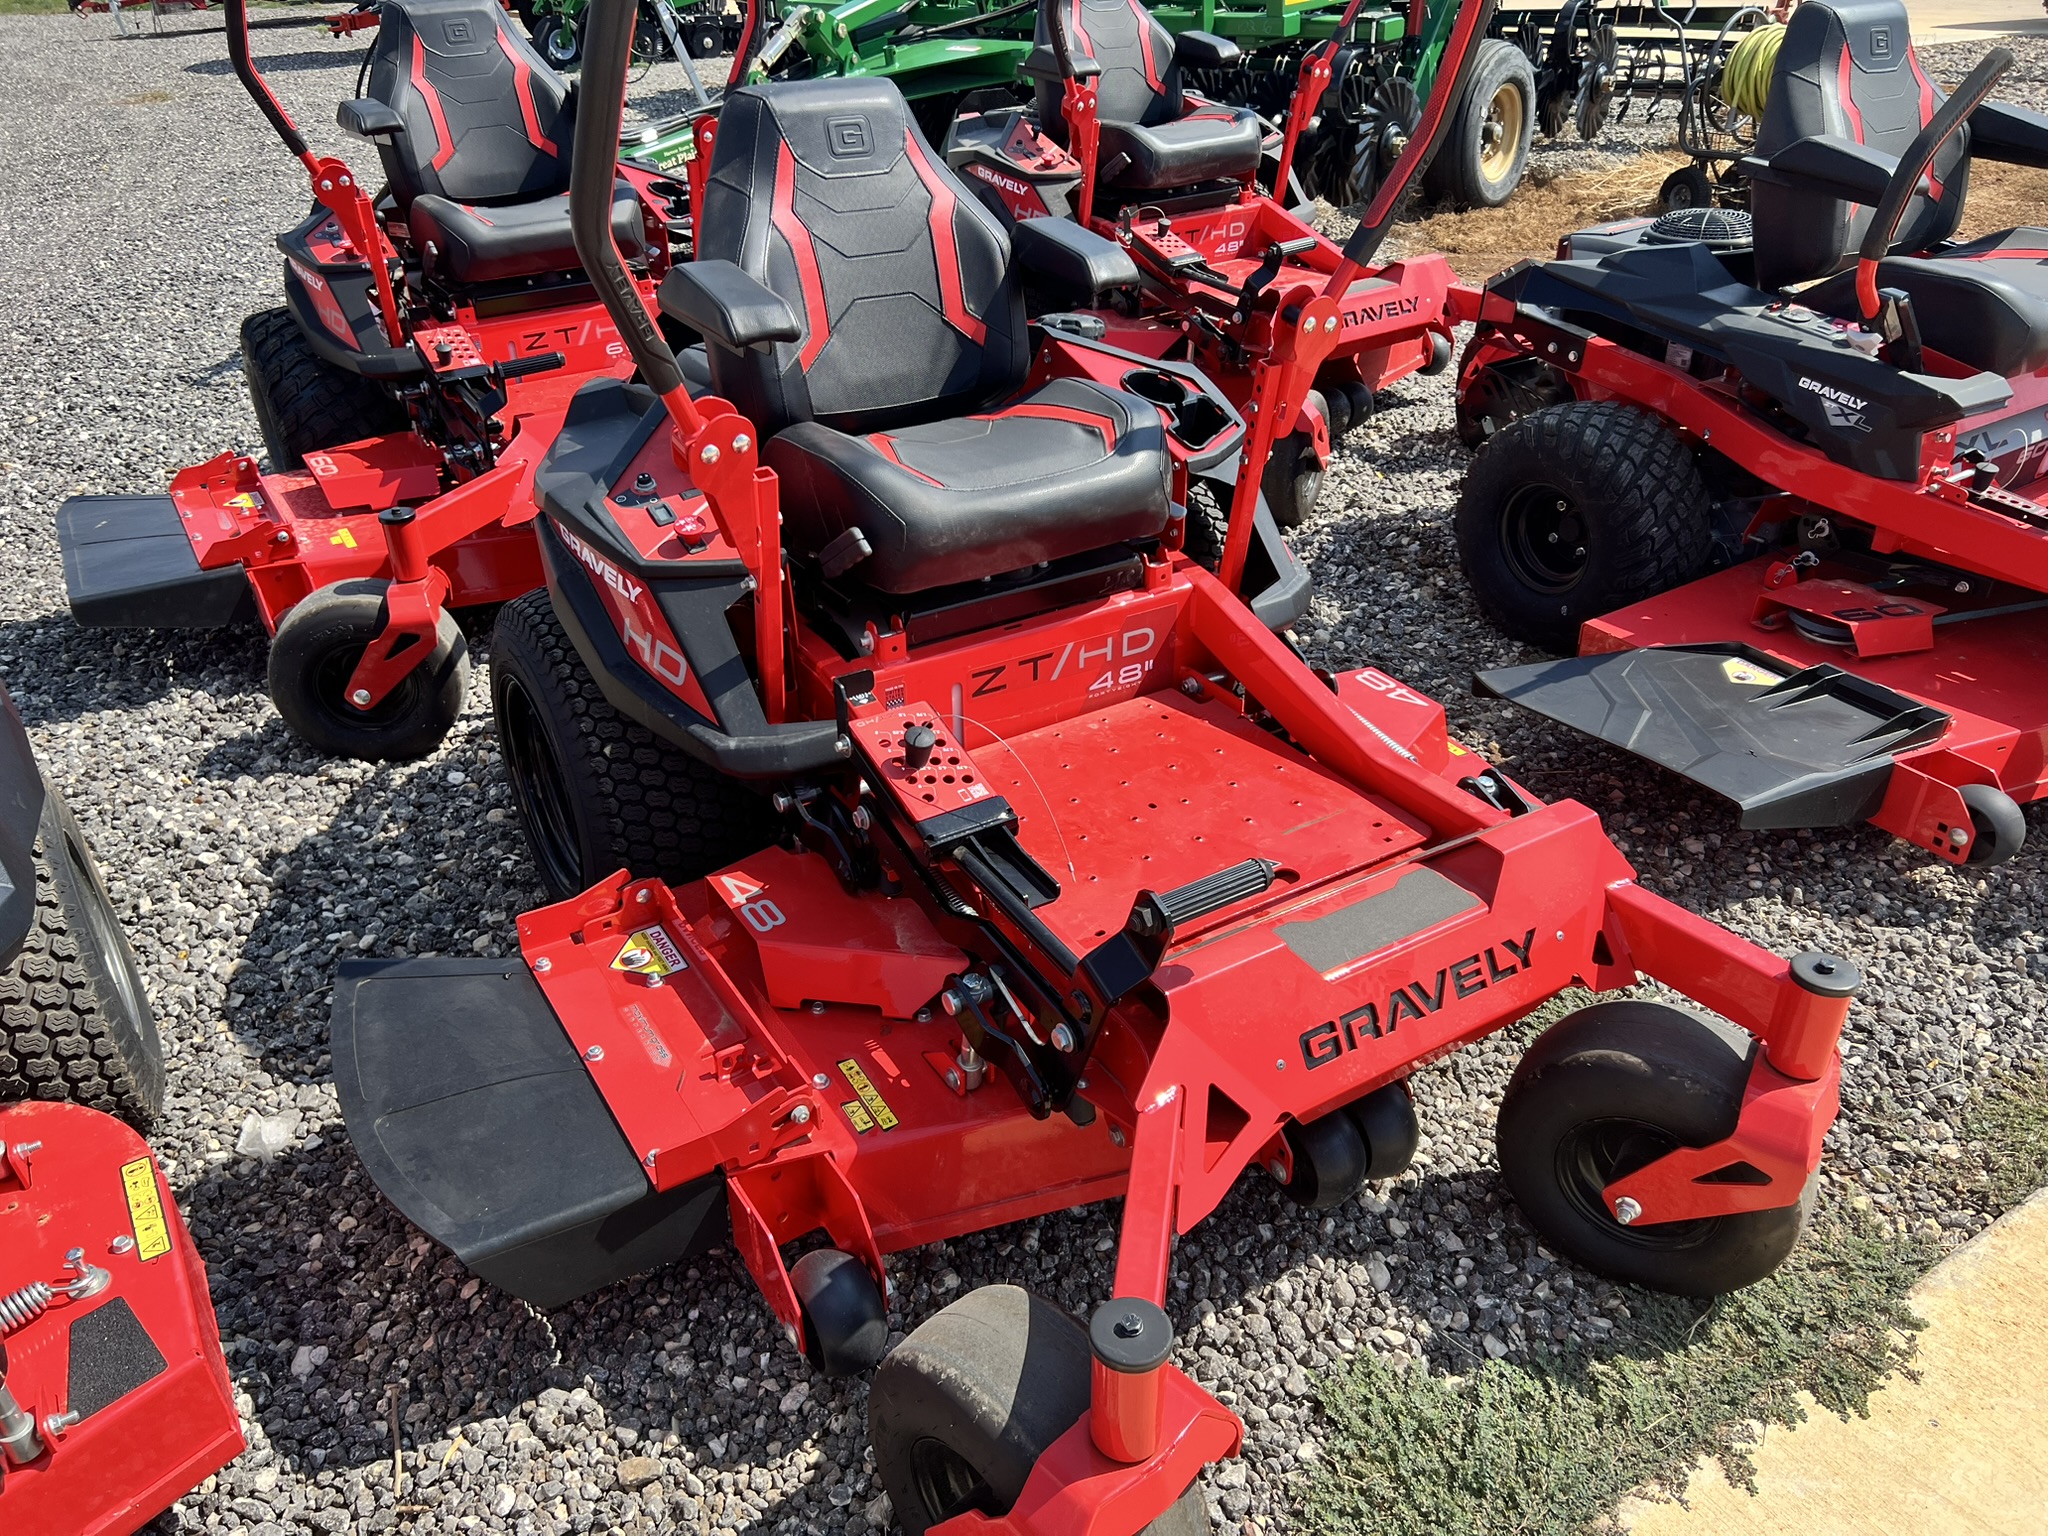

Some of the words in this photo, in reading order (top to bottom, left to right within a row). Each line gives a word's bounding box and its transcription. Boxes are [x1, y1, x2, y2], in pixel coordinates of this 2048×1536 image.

[658, 153, 678, 171] reat
[978, 166, 1028, 195] GRAVELY
[606, 262, 655, 341] GRAVELY
[1341, 296, 1419, 329] RAVELY
[1798, 376, 1868, 410] GRAVELY
[1832, 406, 1873, 433] XL
[309, 456, 339, 476] 60
[559, 523, 643, 605] GRAVELY
[624, 617, 688, 686] HD
[971, 627, 1155, 699] ZT/HD
[1088, 659, 1155, 692] 48"
[1355, 670, 1430, 707] 48
[719, 875, 786, 932] 48
[650, 930, 681, 968] DANGER
[1299, 927, 1536, 1070] GRAVELY
